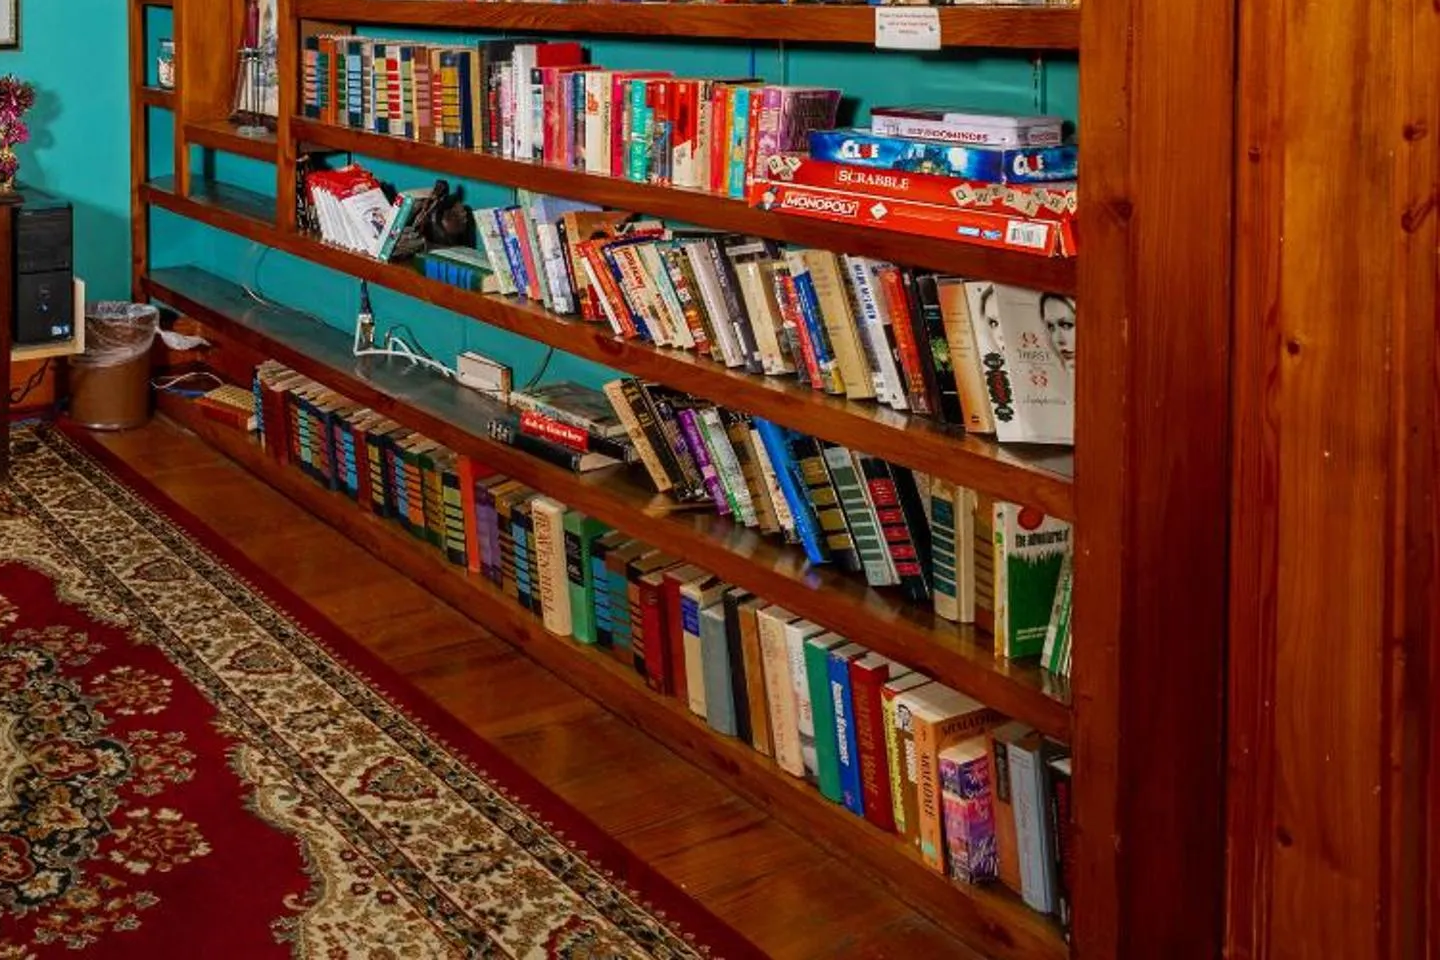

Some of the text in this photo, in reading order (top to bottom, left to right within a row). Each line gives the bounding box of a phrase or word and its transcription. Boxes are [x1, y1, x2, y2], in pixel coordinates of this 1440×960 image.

[841, 139, 880, 159] CLUE
[1013, 154, 1044, 176] CLUE
[837, 168, 910, 190] SCRABBLE
[783, 195, 857, 216] MONOPOLY
